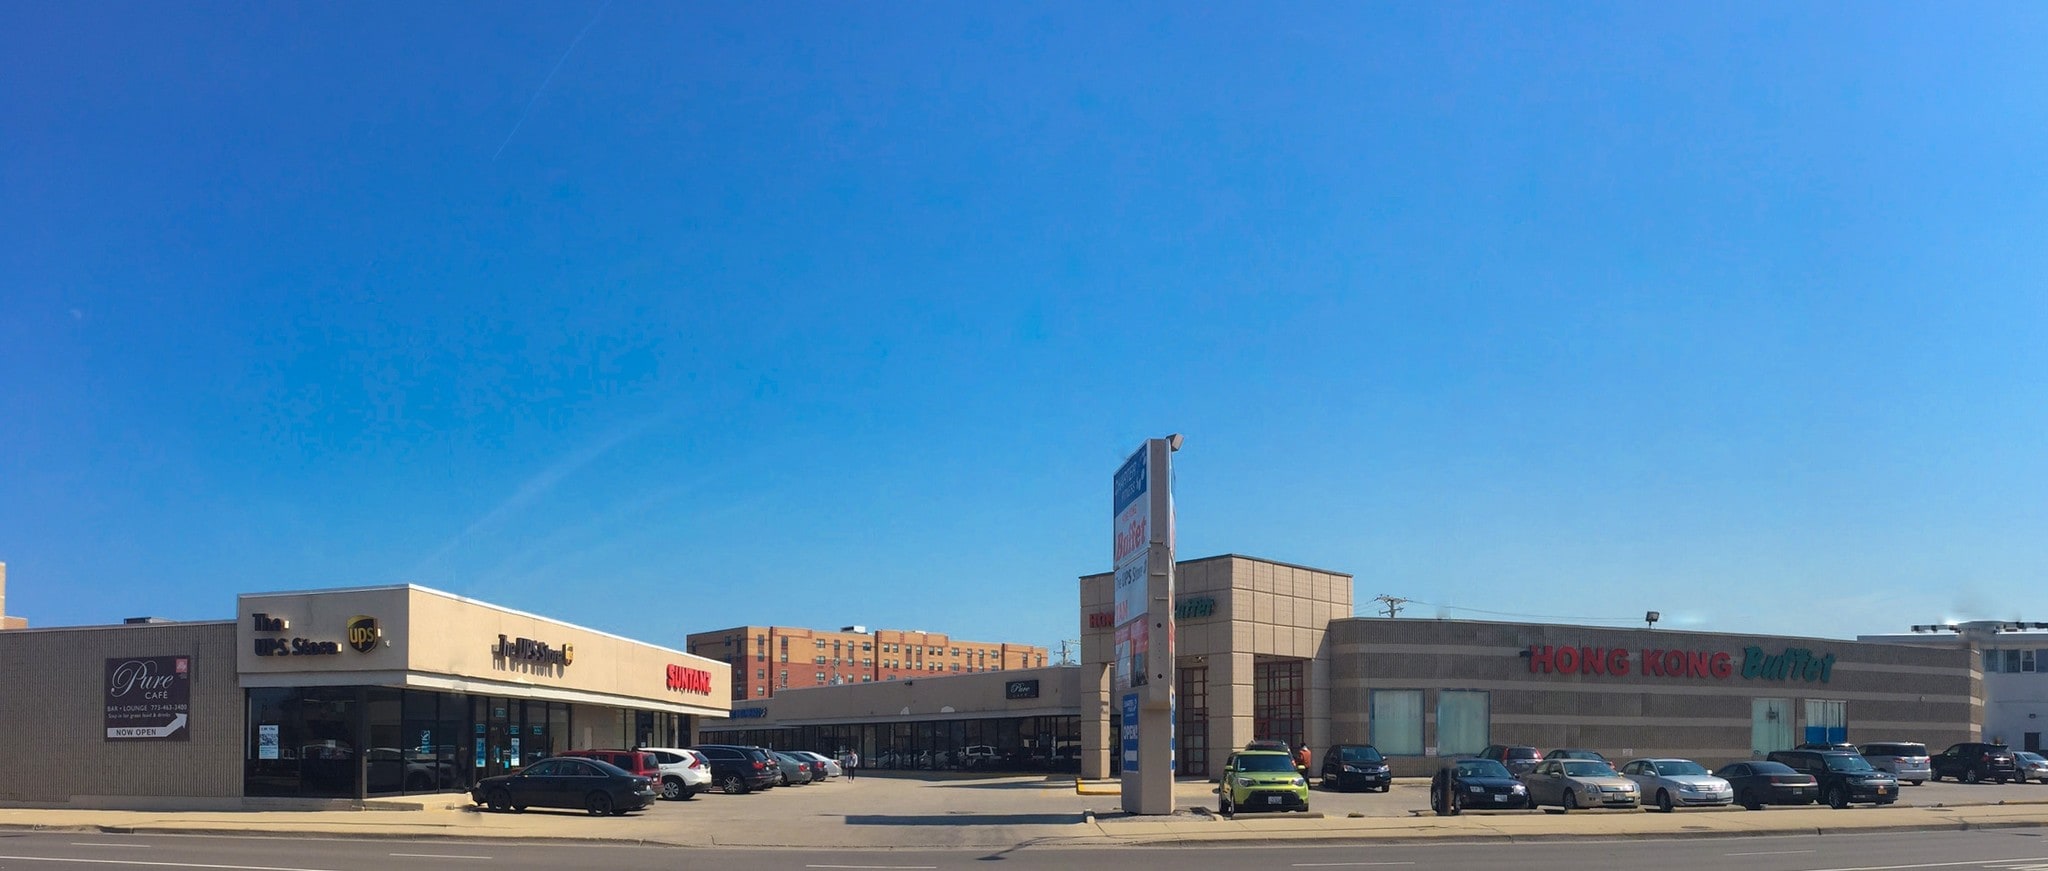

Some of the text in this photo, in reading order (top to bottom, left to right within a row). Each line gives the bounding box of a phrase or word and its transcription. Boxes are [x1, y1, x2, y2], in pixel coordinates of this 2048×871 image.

[1116, 516, 1146, 561] Buffet
[1122, 568, 1132, 588] UPS
[252, 613, 284, 632] The
[1089, 596, 1215, 629] HON uffet
[254, 638, 290, 656] UPS
[349, 627, 375, 649] ups
[1528, 644, 1836, 684] HONG KONG Buffet
[110, 660, 174, 698] Pure
[666, 663, 712, 694] SUNTANZ
[144, 690, 168, 700] CAFÉ
[123, 704, 148, 712] LOUNGE
